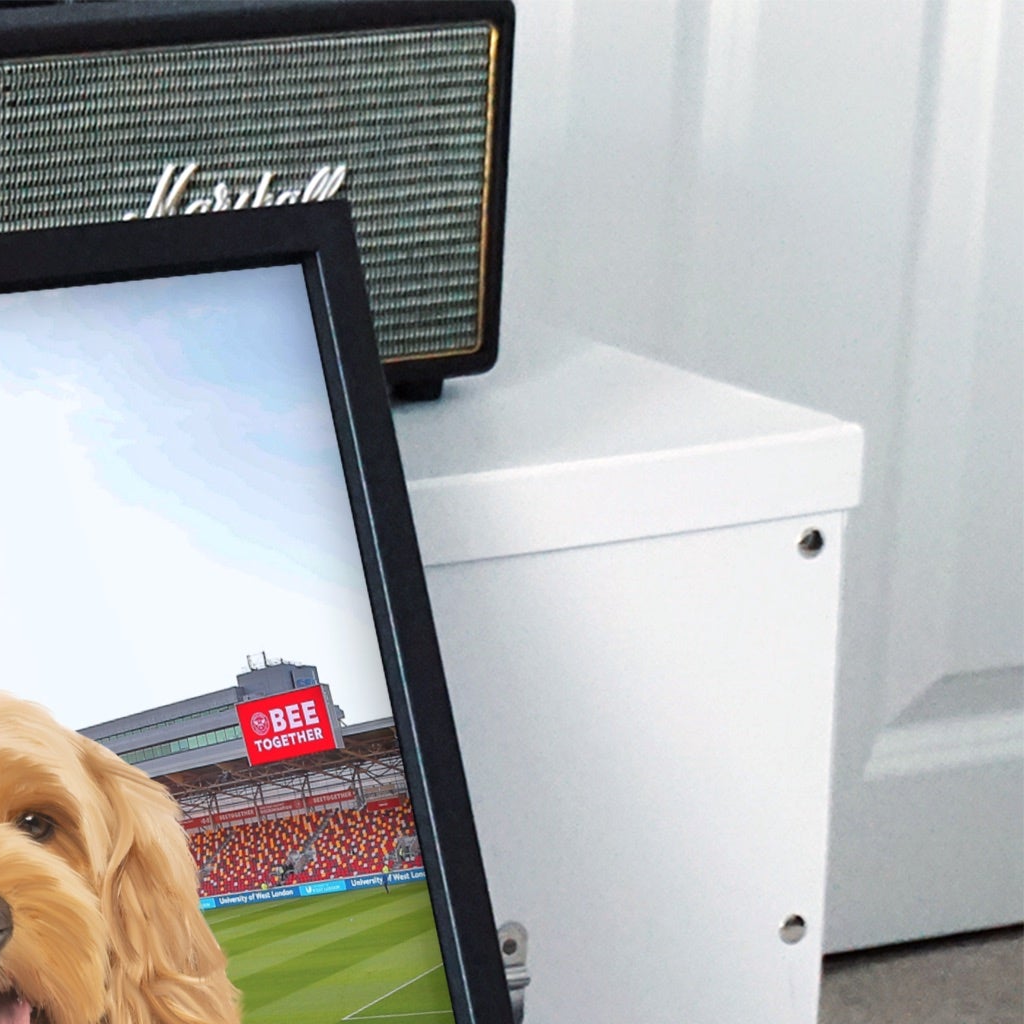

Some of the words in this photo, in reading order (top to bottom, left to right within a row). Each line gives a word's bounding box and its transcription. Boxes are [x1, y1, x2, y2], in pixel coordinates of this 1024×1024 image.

[123, 163, 346, 220] Marshall
[269, 700, 320, 733] BEE
[254, 727, 324, 752] TOGETHER
[350, 876, 383, 887] University
[392, 871, 410, 881] West
[219, 895, 249, 904] University
[248, 893, 256, 901] of
[256, 892, 271, 900] West
[271, 889, 294, 898] London
